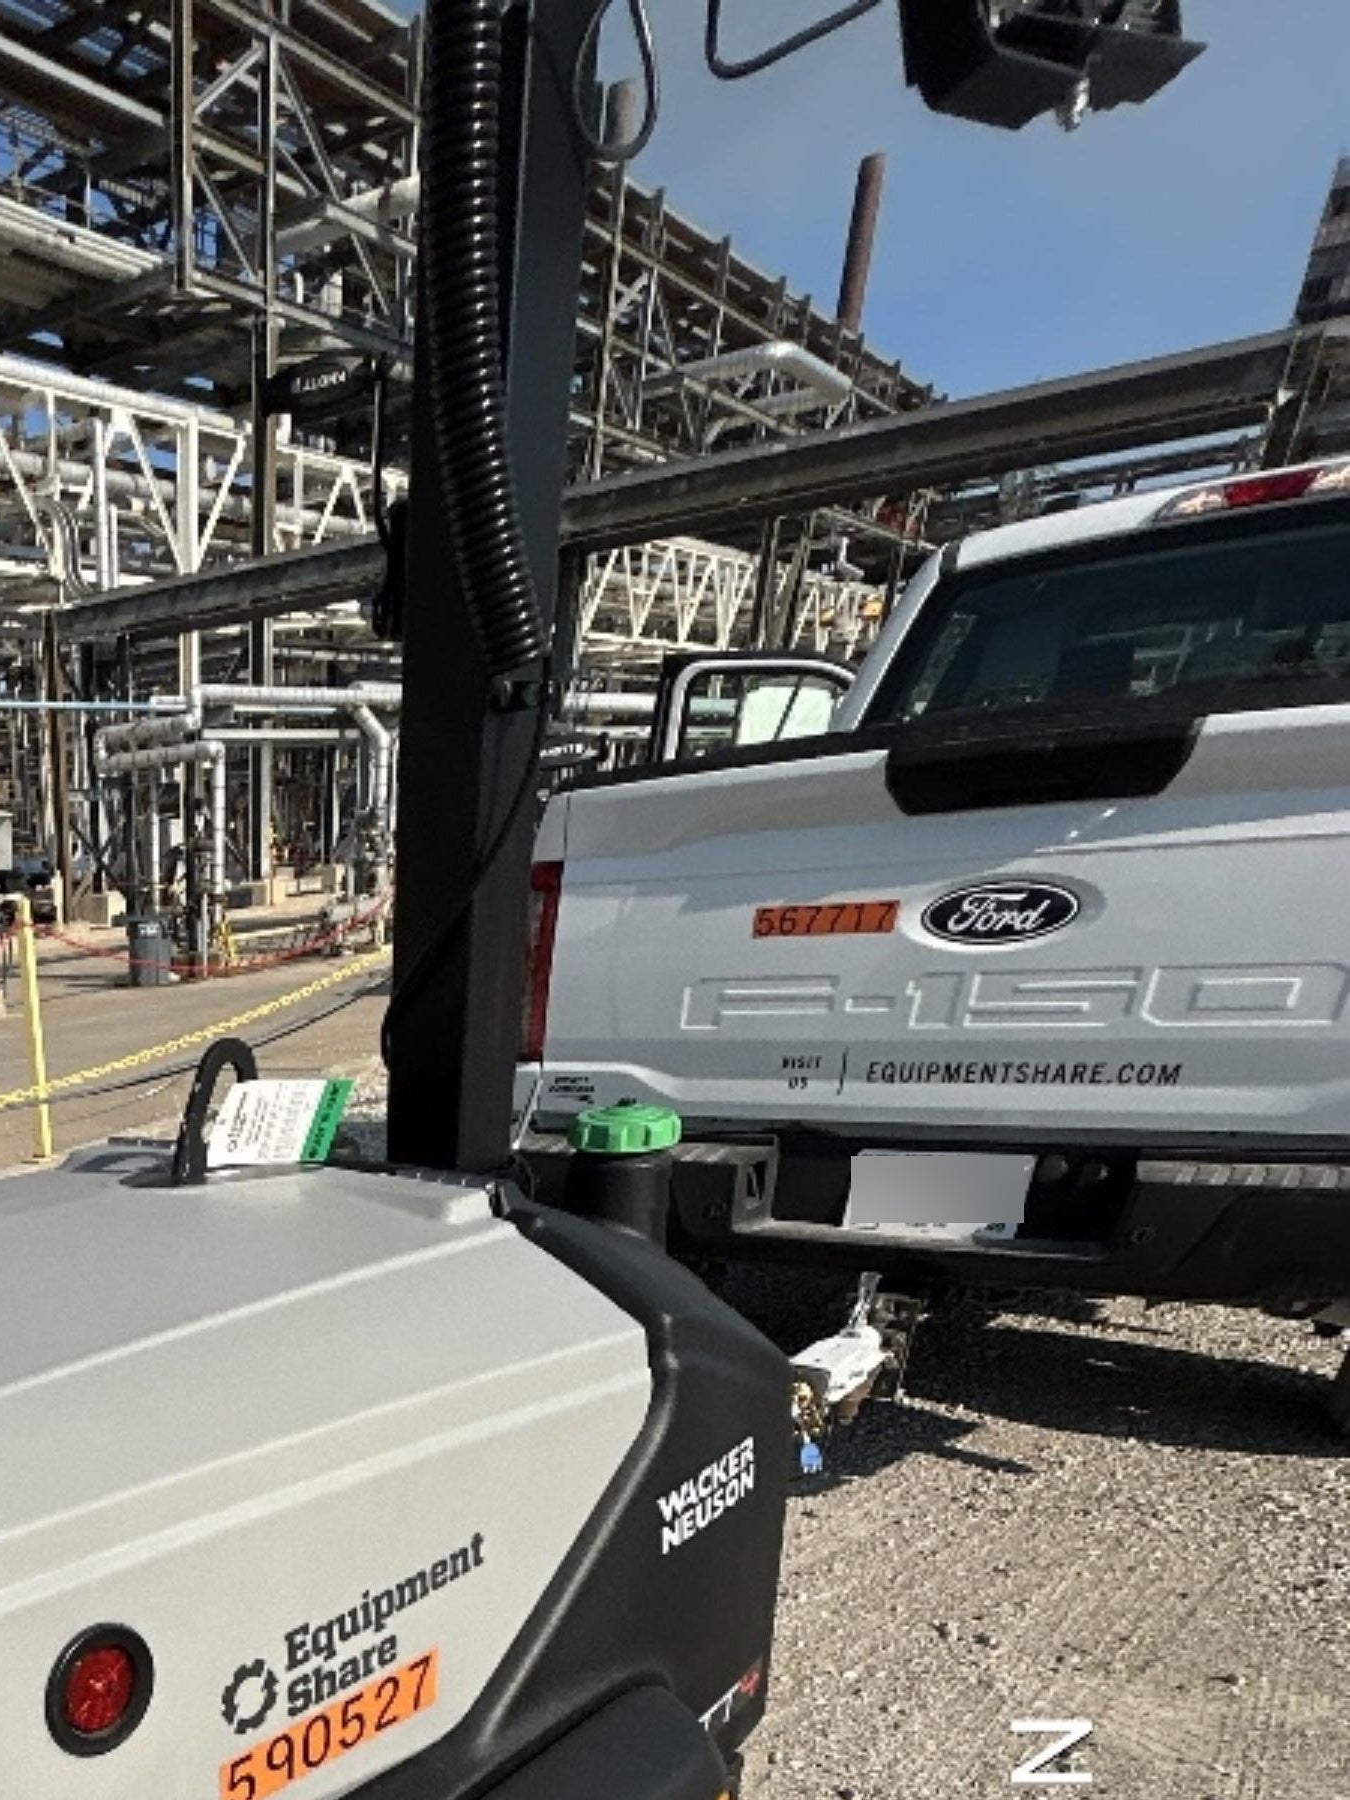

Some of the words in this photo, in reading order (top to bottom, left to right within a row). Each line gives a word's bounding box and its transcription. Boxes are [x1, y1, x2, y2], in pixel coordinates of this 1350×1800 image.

[756, 902, 895, 935] 567717
[949, 892, 1051, 933] Ford
[681, 963, 1350, 1030] F-150
[782, 1055, 822, 1070] VISIT
[866, 1062, 1182, 1087] EQUIPMENTSHARE.COM
[656, 1436, 755, 1520] WACKER
[660, 1464, 755, 1555] NEUSON
[284, 1531, 484, 1671] Equipment
[286, 1633, 398, 1717] Share
